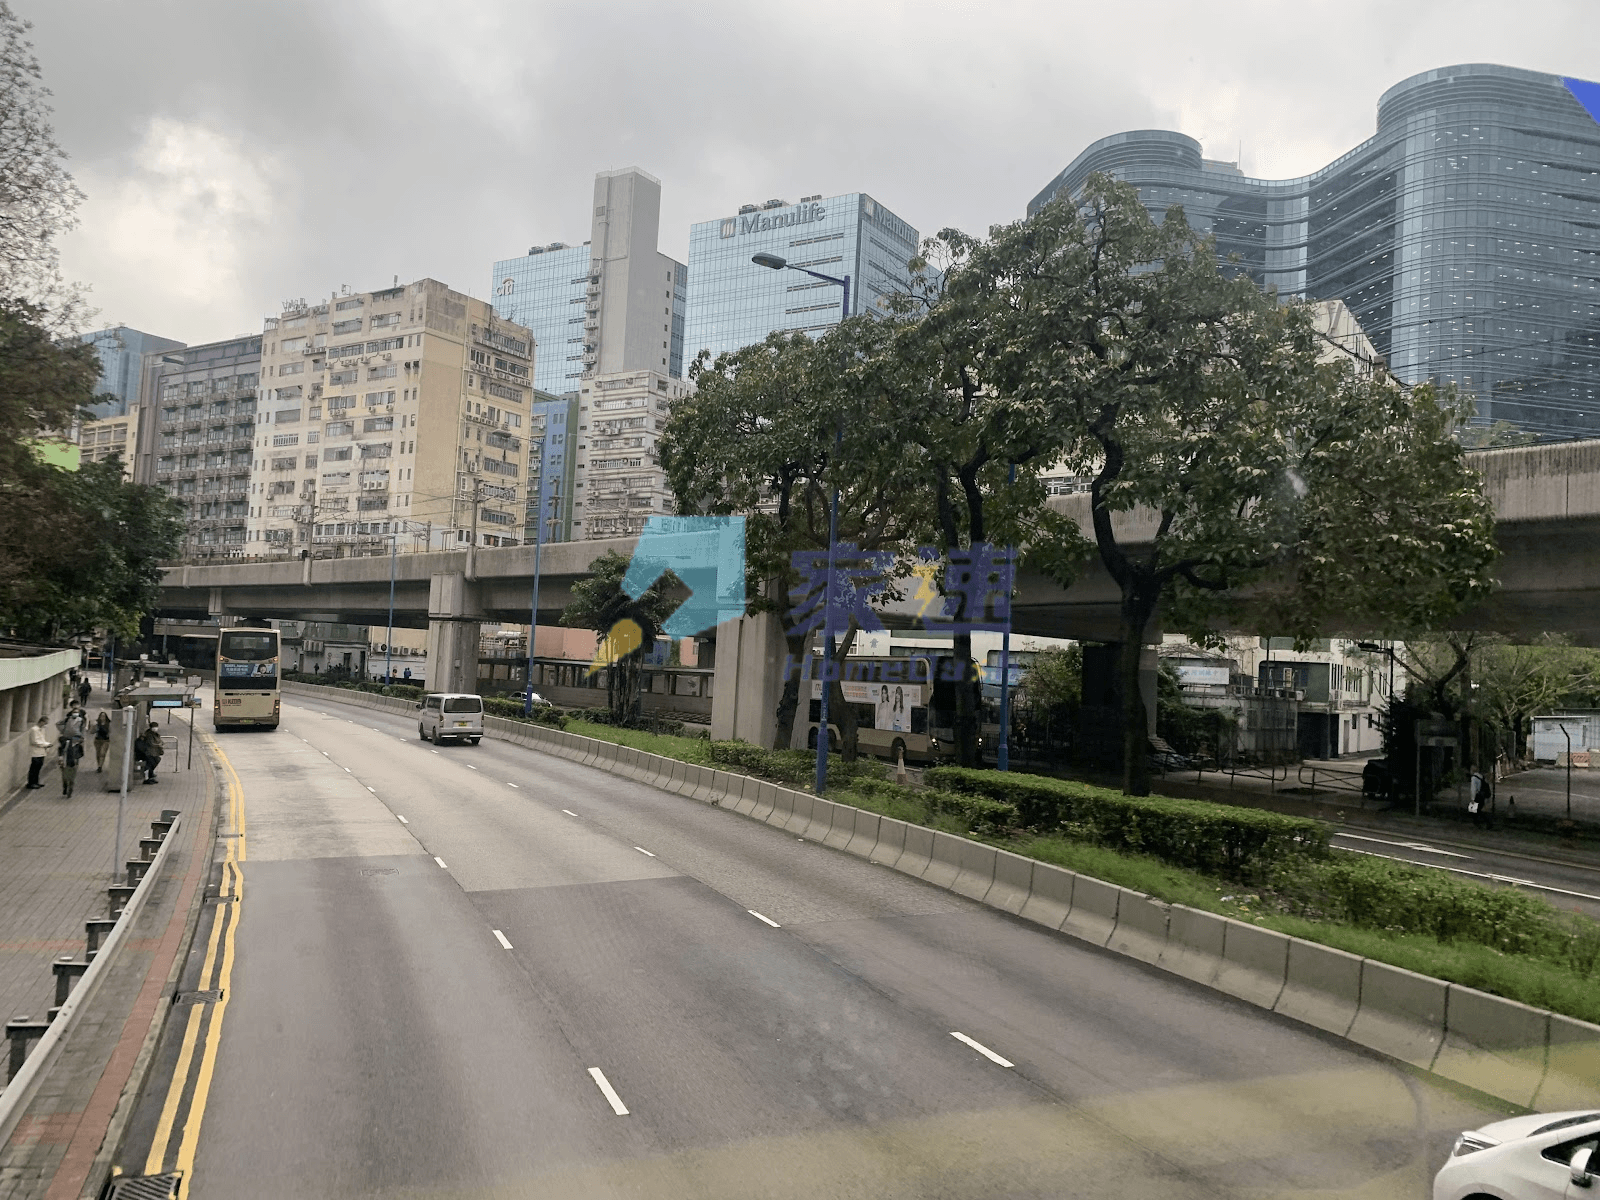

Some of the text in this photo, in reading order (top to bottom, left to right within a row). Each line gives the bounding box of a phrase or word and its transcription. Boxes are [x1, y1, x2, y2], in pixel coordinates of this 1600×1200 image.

[739, 202, 826, 236] Manulife
[875, 203, 919, 246] Manulife
[496, 277, 515, 297] citi
